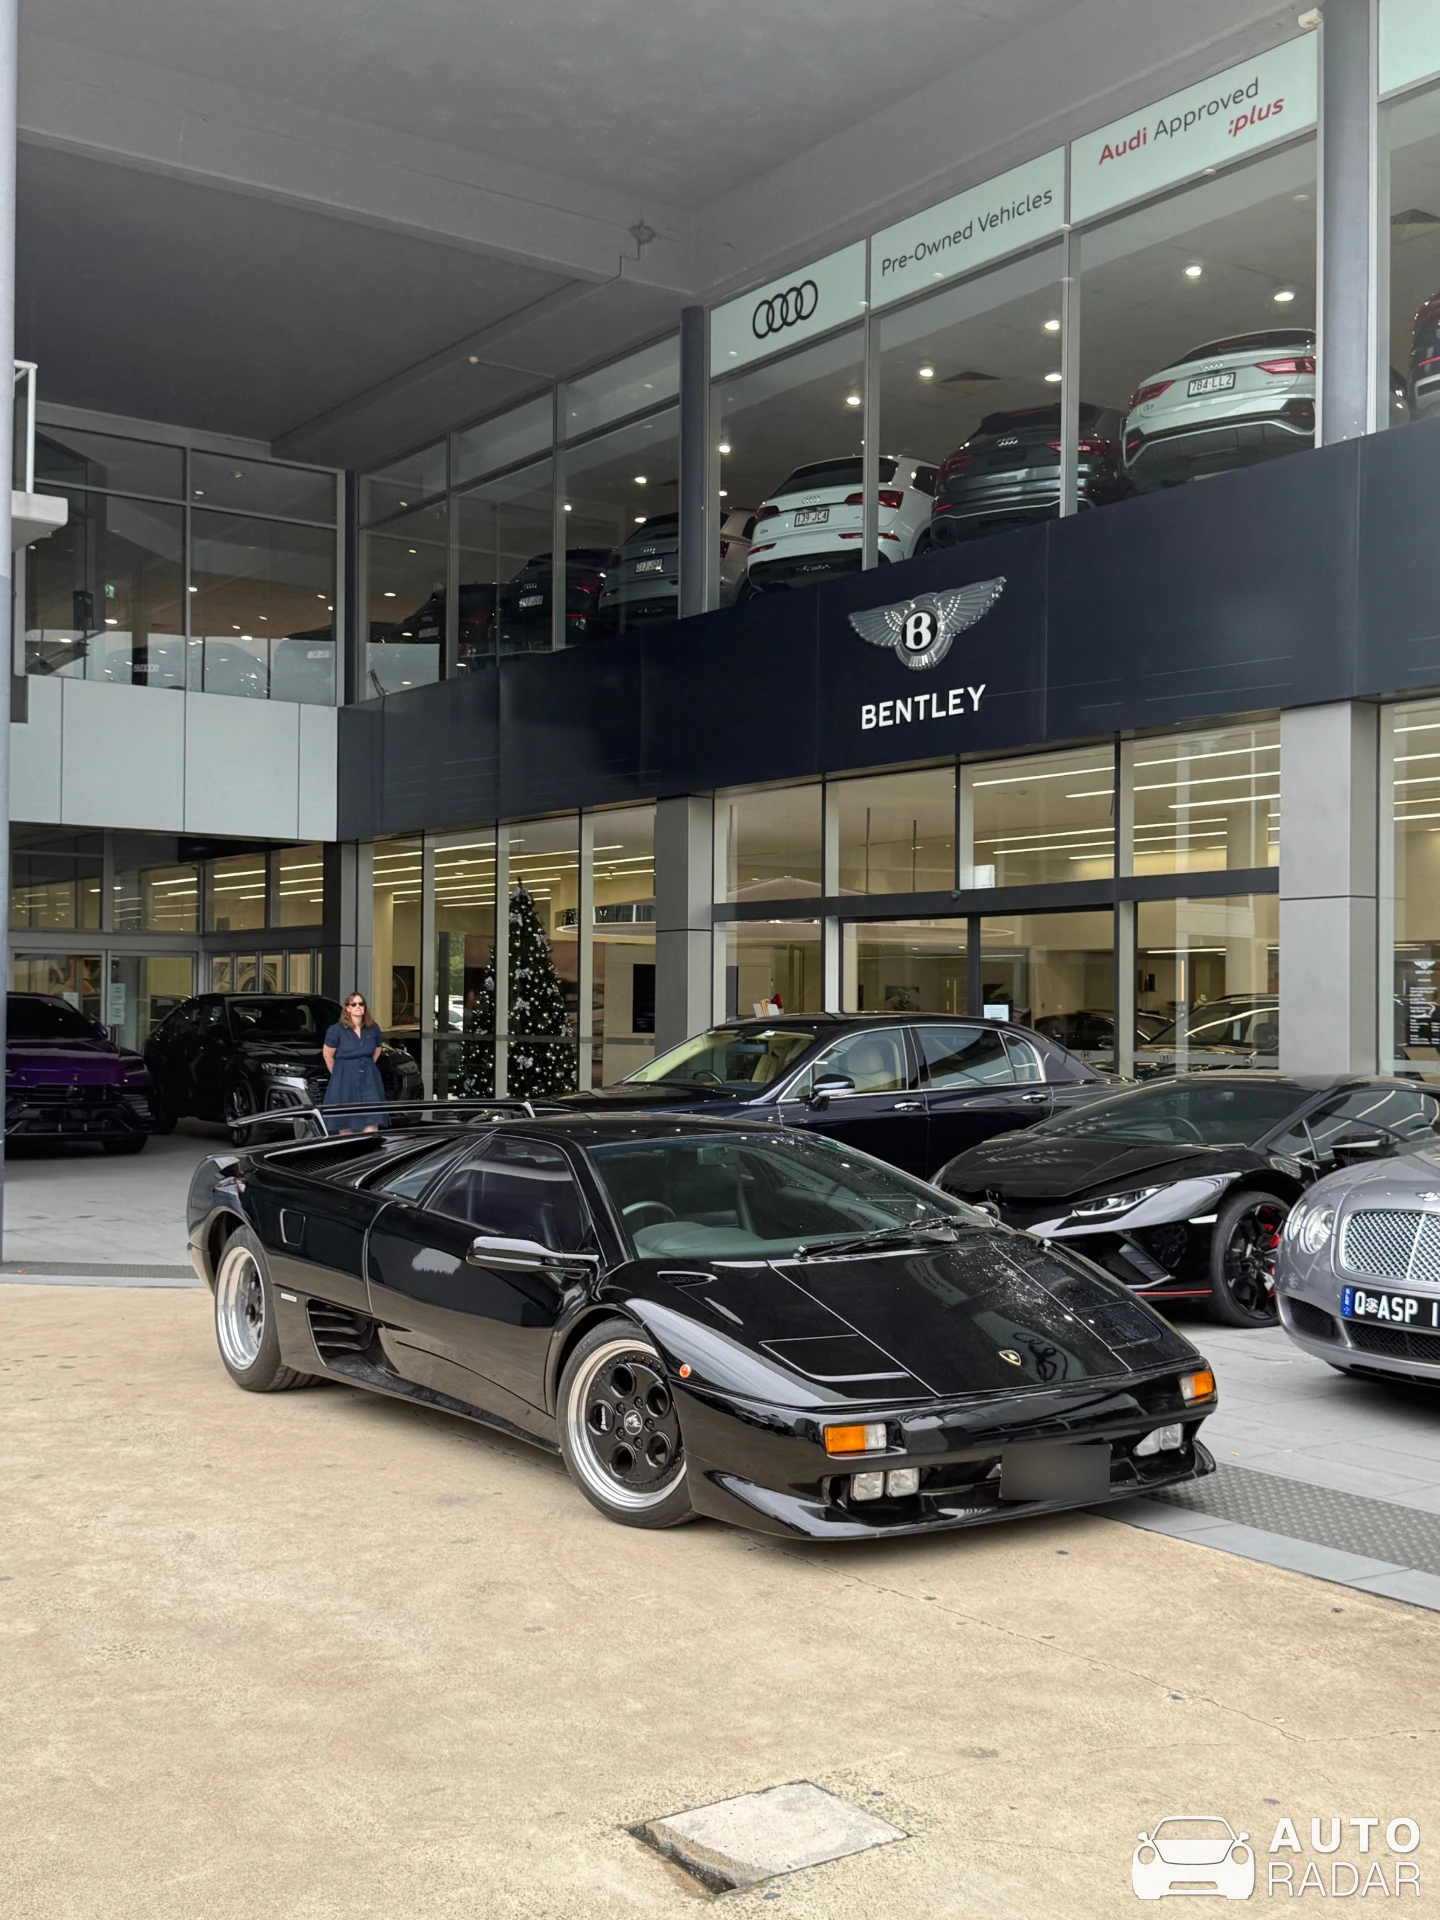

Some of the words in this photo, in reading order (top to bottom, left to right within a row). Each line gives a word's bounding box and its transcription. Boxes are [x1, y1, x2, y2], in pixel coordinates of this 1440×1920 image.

[1099, 127, 1147, 165] Audi
[1153, 77, 1259, 140] Approved
[1228, 98, 1285, 137] :plus
[882, 221, 973, 276] Pre-Owned
[978, 189, 1053, 232] Vehicles
[905, 612, 932, 650] B
[861, 684, 986, 730] BENTLEY
